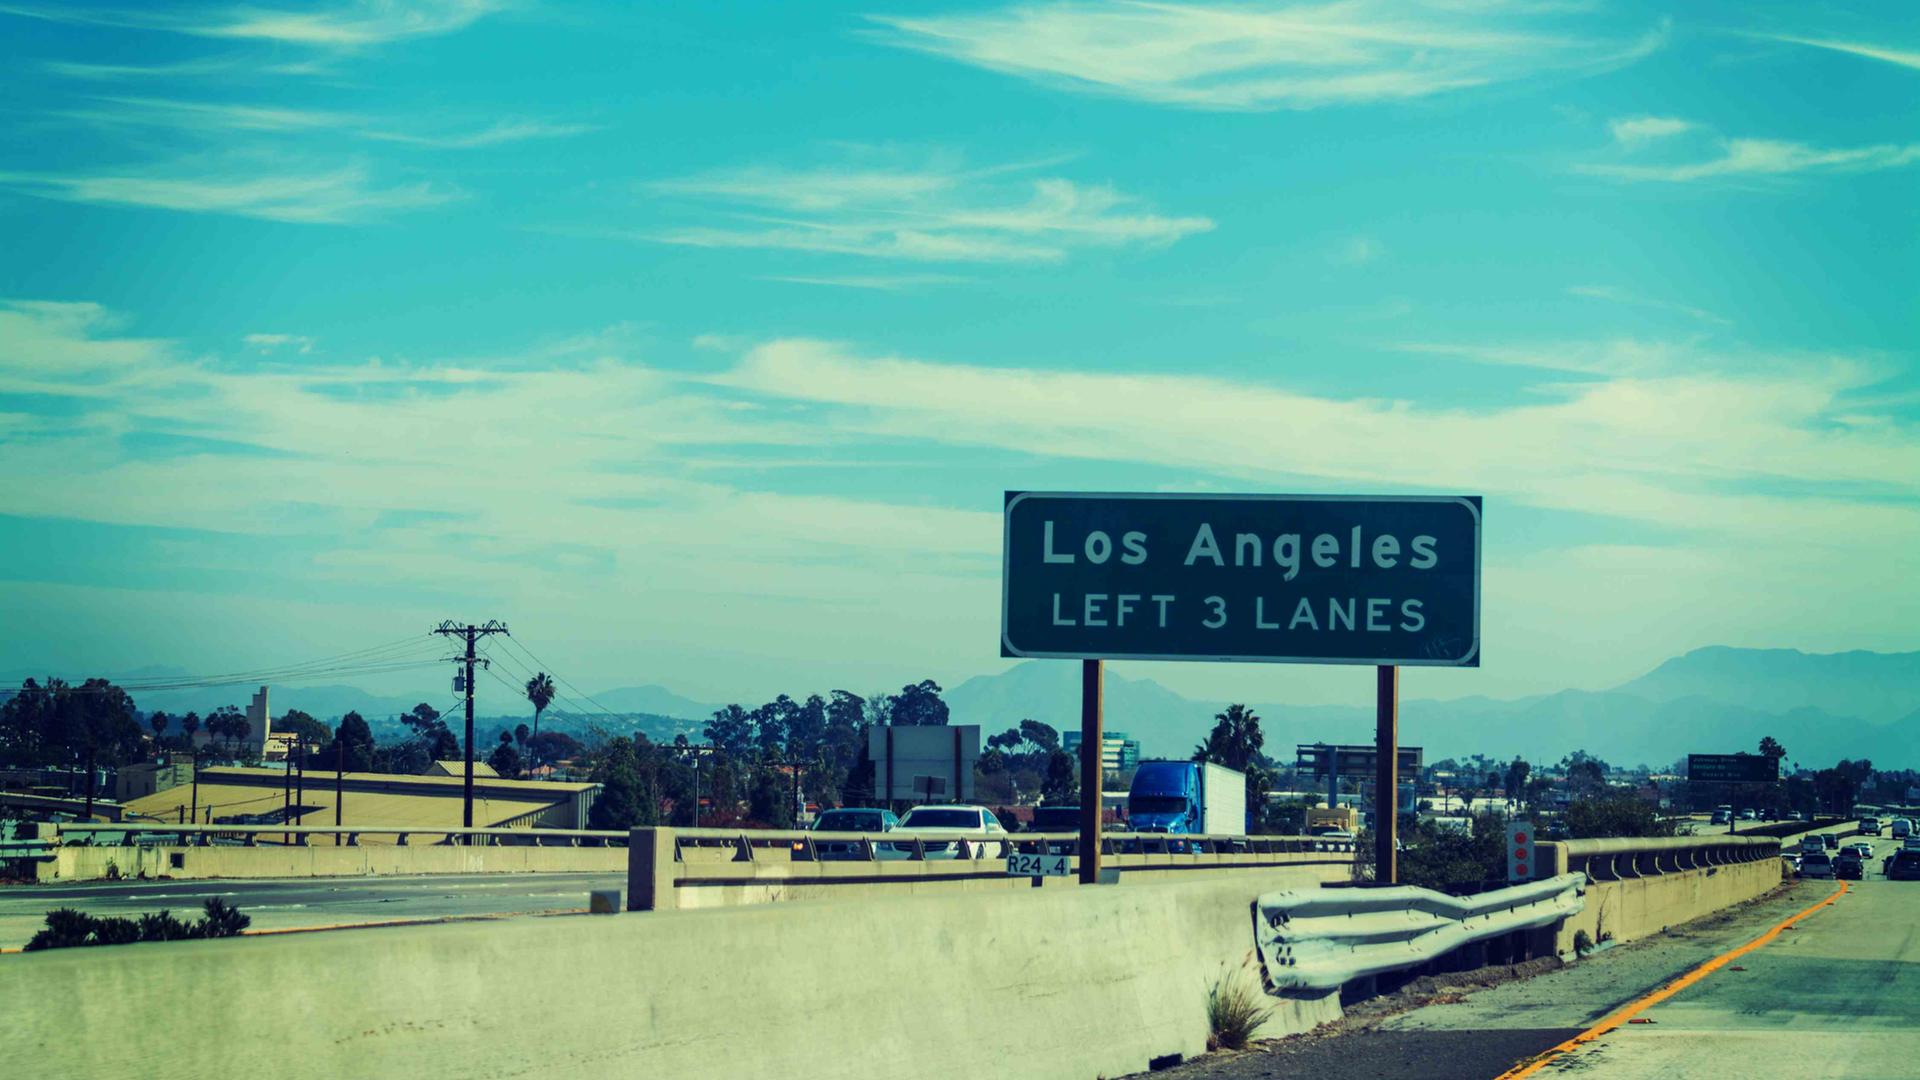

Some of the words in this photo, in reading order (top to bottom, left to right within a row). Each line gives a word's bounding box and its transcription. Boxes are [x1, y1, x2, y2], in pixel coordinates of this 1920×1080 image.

[1043, 520, 1148, 565] Los
[1184, 523, 1438, 581] Angeles
[1053, 594, 1175, 628] LEFT
[1202, 595, 1227, 629] 3
[1256, 596, 1425, 632] LANES
[1008, 856, 1065, 874] R24.4
